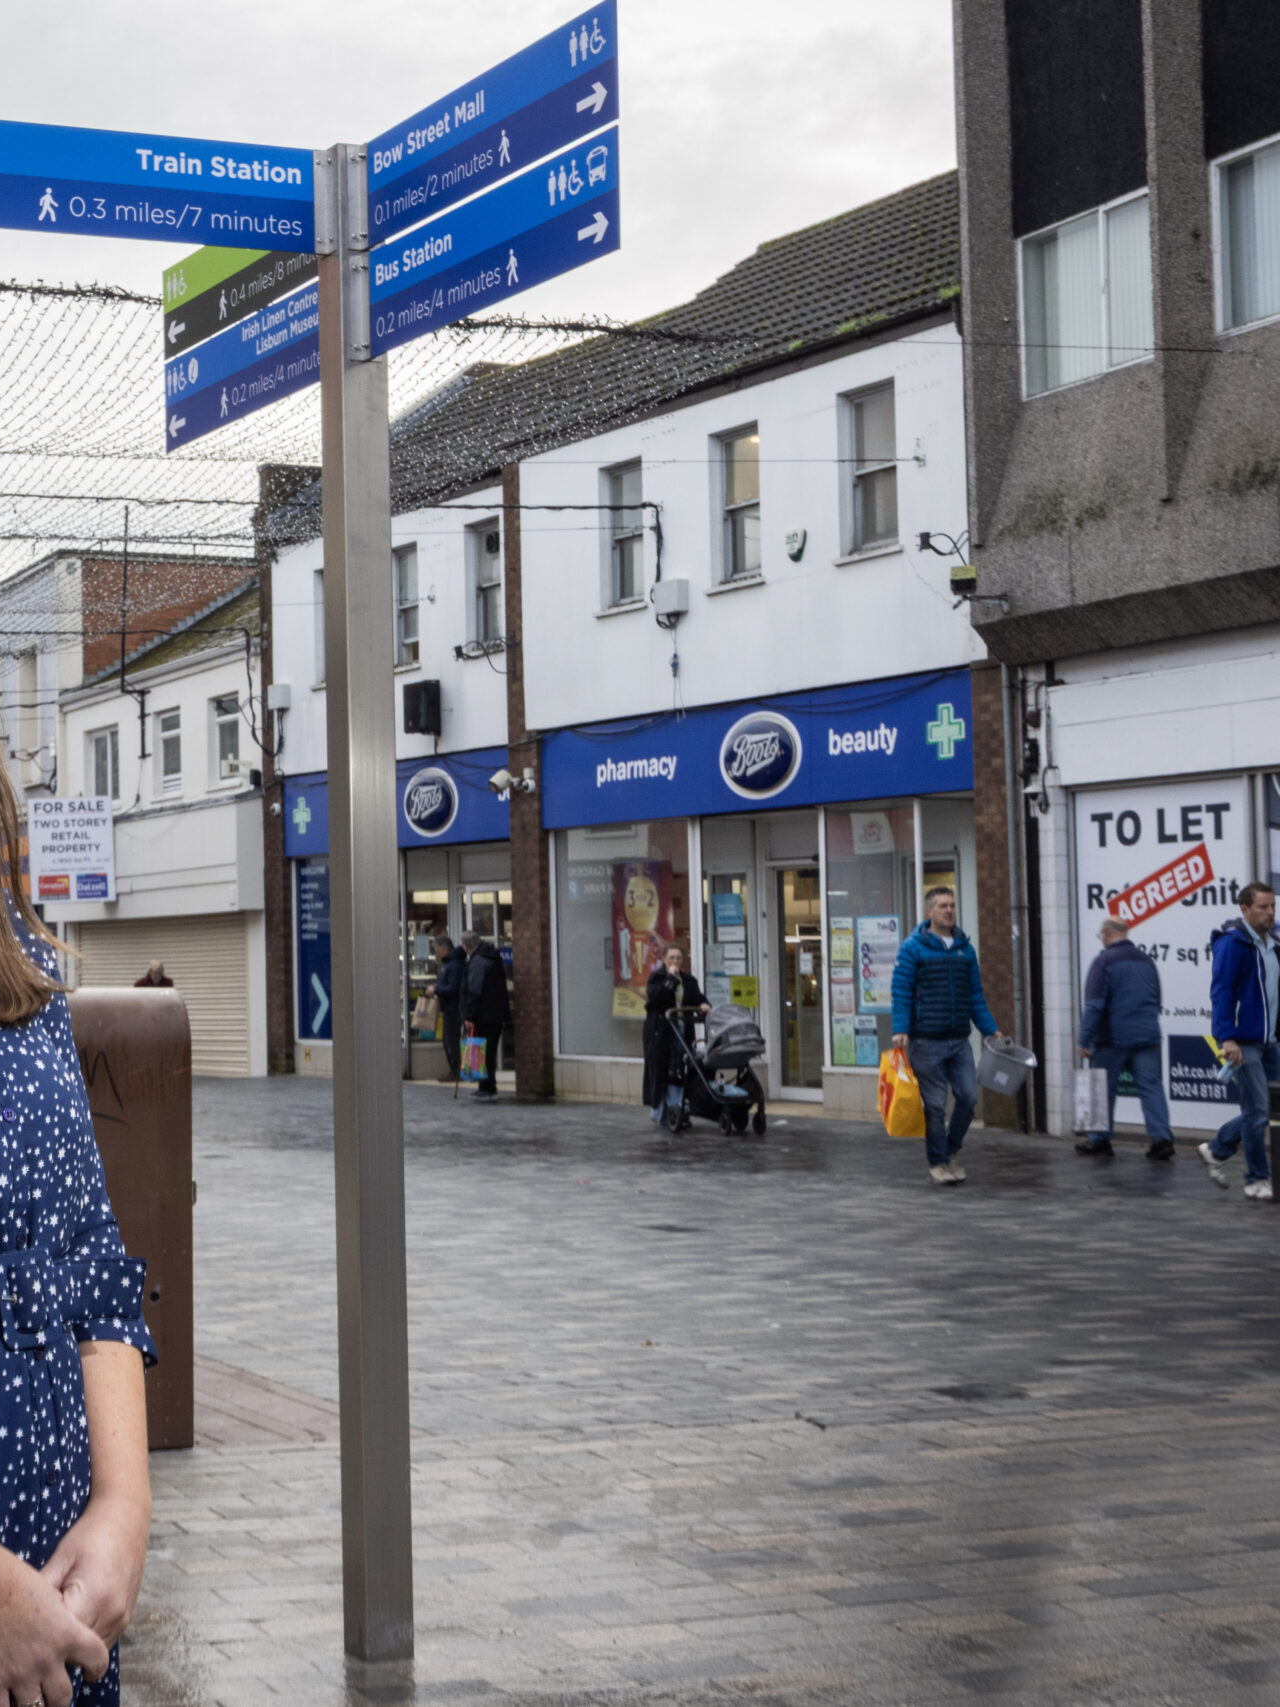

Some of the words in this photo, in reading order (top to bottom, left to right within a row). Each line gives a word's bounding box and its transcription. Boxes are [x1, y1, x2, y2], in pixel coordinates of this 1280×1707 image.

[373, 142, 403, 175] Bow
[406, 111, 451, 155] Street
[454, 90, 485, 127] Mall
[136, 148, 202, 176] Train
[210, 153, 302, 185] Station
[374, 201, 390, 225] 0.1
[392, 174, 438, 218] miles/2
[440, 148, 494, 191] minutes
[69, 195, 106, 219] 0.3
[114, 198, 202, 229] miles/7
[210, 209, 303, 236] minutes
[230, 287, 246, 307] 0.4
[248, 264, 285, 294] miles/8
[286, 252, 318, 274] minu
[375, 257, 399, 287] Bus
[402, 232, 452, 275] Station
[241, 321, 260, 342] Irish
[261, 308, 286, 332] Linen
[287, 293, 318, 317] Centre
[375, 311, 396, 338] 0.2
[397, 288, 444, 330] miles/4
[447, 265, 501, 306] minutes
[256, 330, 288, 356] Lisburn
[289, 313, 318, 338] Museu
[231, 386, 247, 406] 0.2
[248, 364, 285, 397] miles/4
[287, 350, 320, 378] minute
[728, 731, 784, 776] Boots
[828, 723, 897, 756] beauty
[596, 755, 677, 788] pharmacy
[34, 802, 63, 814] FOR
[68, 800, 104, 813] SALE
[410, 785, 442, 819] Boots
[33, 819, 60, 829] TWO
[63, 818, 108, 828] STOREY
[51, 831, 91, 841] RETAIL
[1091, 810, 1141, 848] TO
[1157, 803, 1230, 844] LET
[41, 843, 101, 854] PROPERTY
[628, 890, 635, 908] 3
[647, 890, 655, 907] 2
[1117, 854, 1206, 922] AGREED
[1177, 948, 1198, 966] sq
